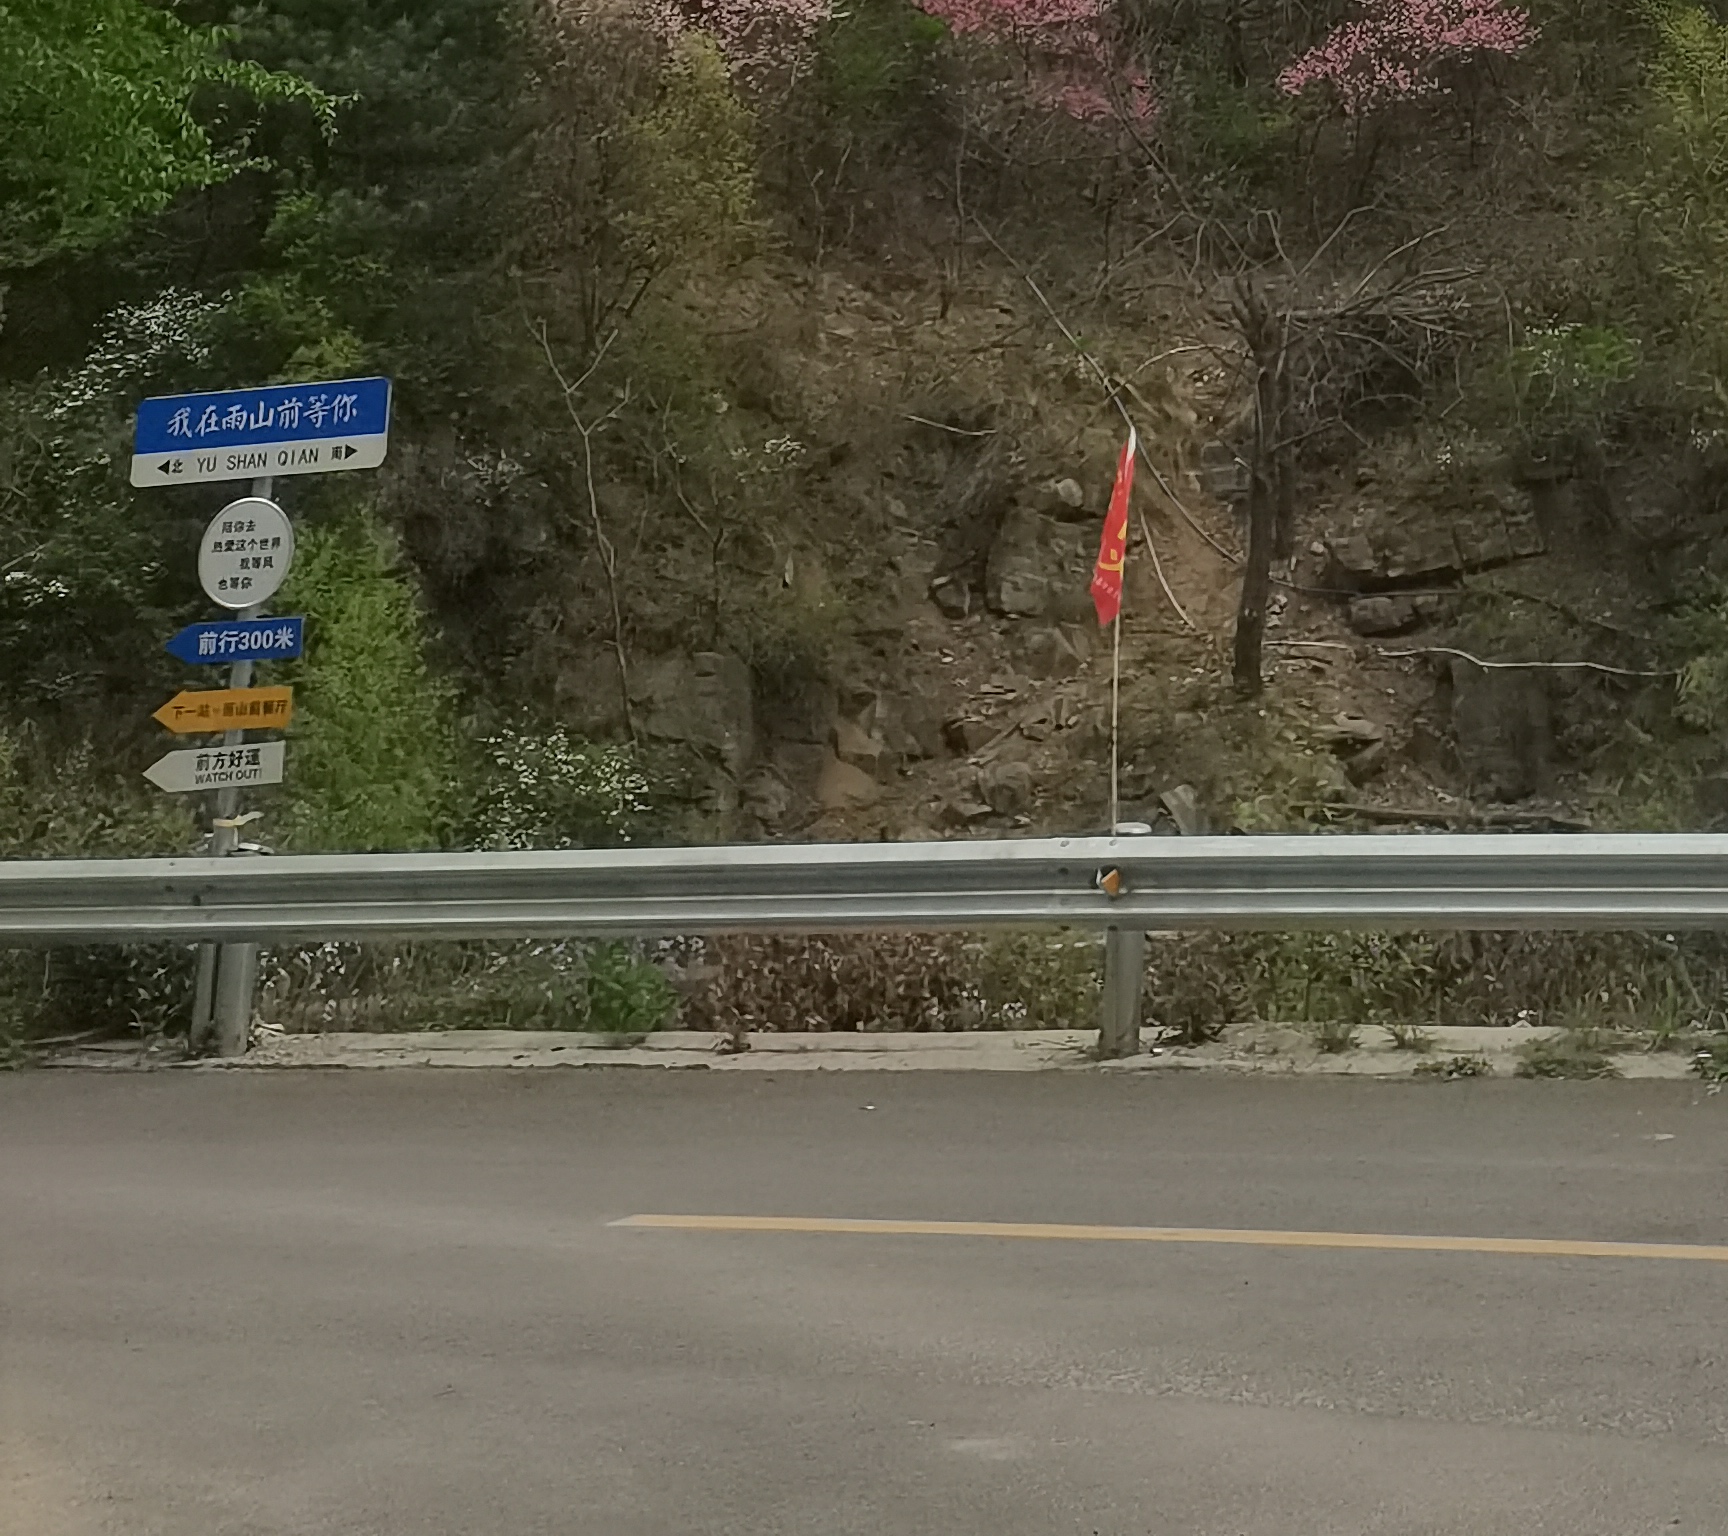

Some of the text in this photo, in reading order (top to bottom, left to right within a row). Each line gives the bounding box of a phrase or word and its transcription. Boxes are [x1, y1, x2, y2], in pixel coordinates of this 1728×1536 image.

[166, 393, 359, 439] 我在雨山前等你
[197, 454, 217, 473] YU
[226, 452, 268, 470] SHAN
[277, 447, 320, 466] QIAN
[198, 625, 294, 656] 前行300米
[194, 770, 234, 785] WATCH
